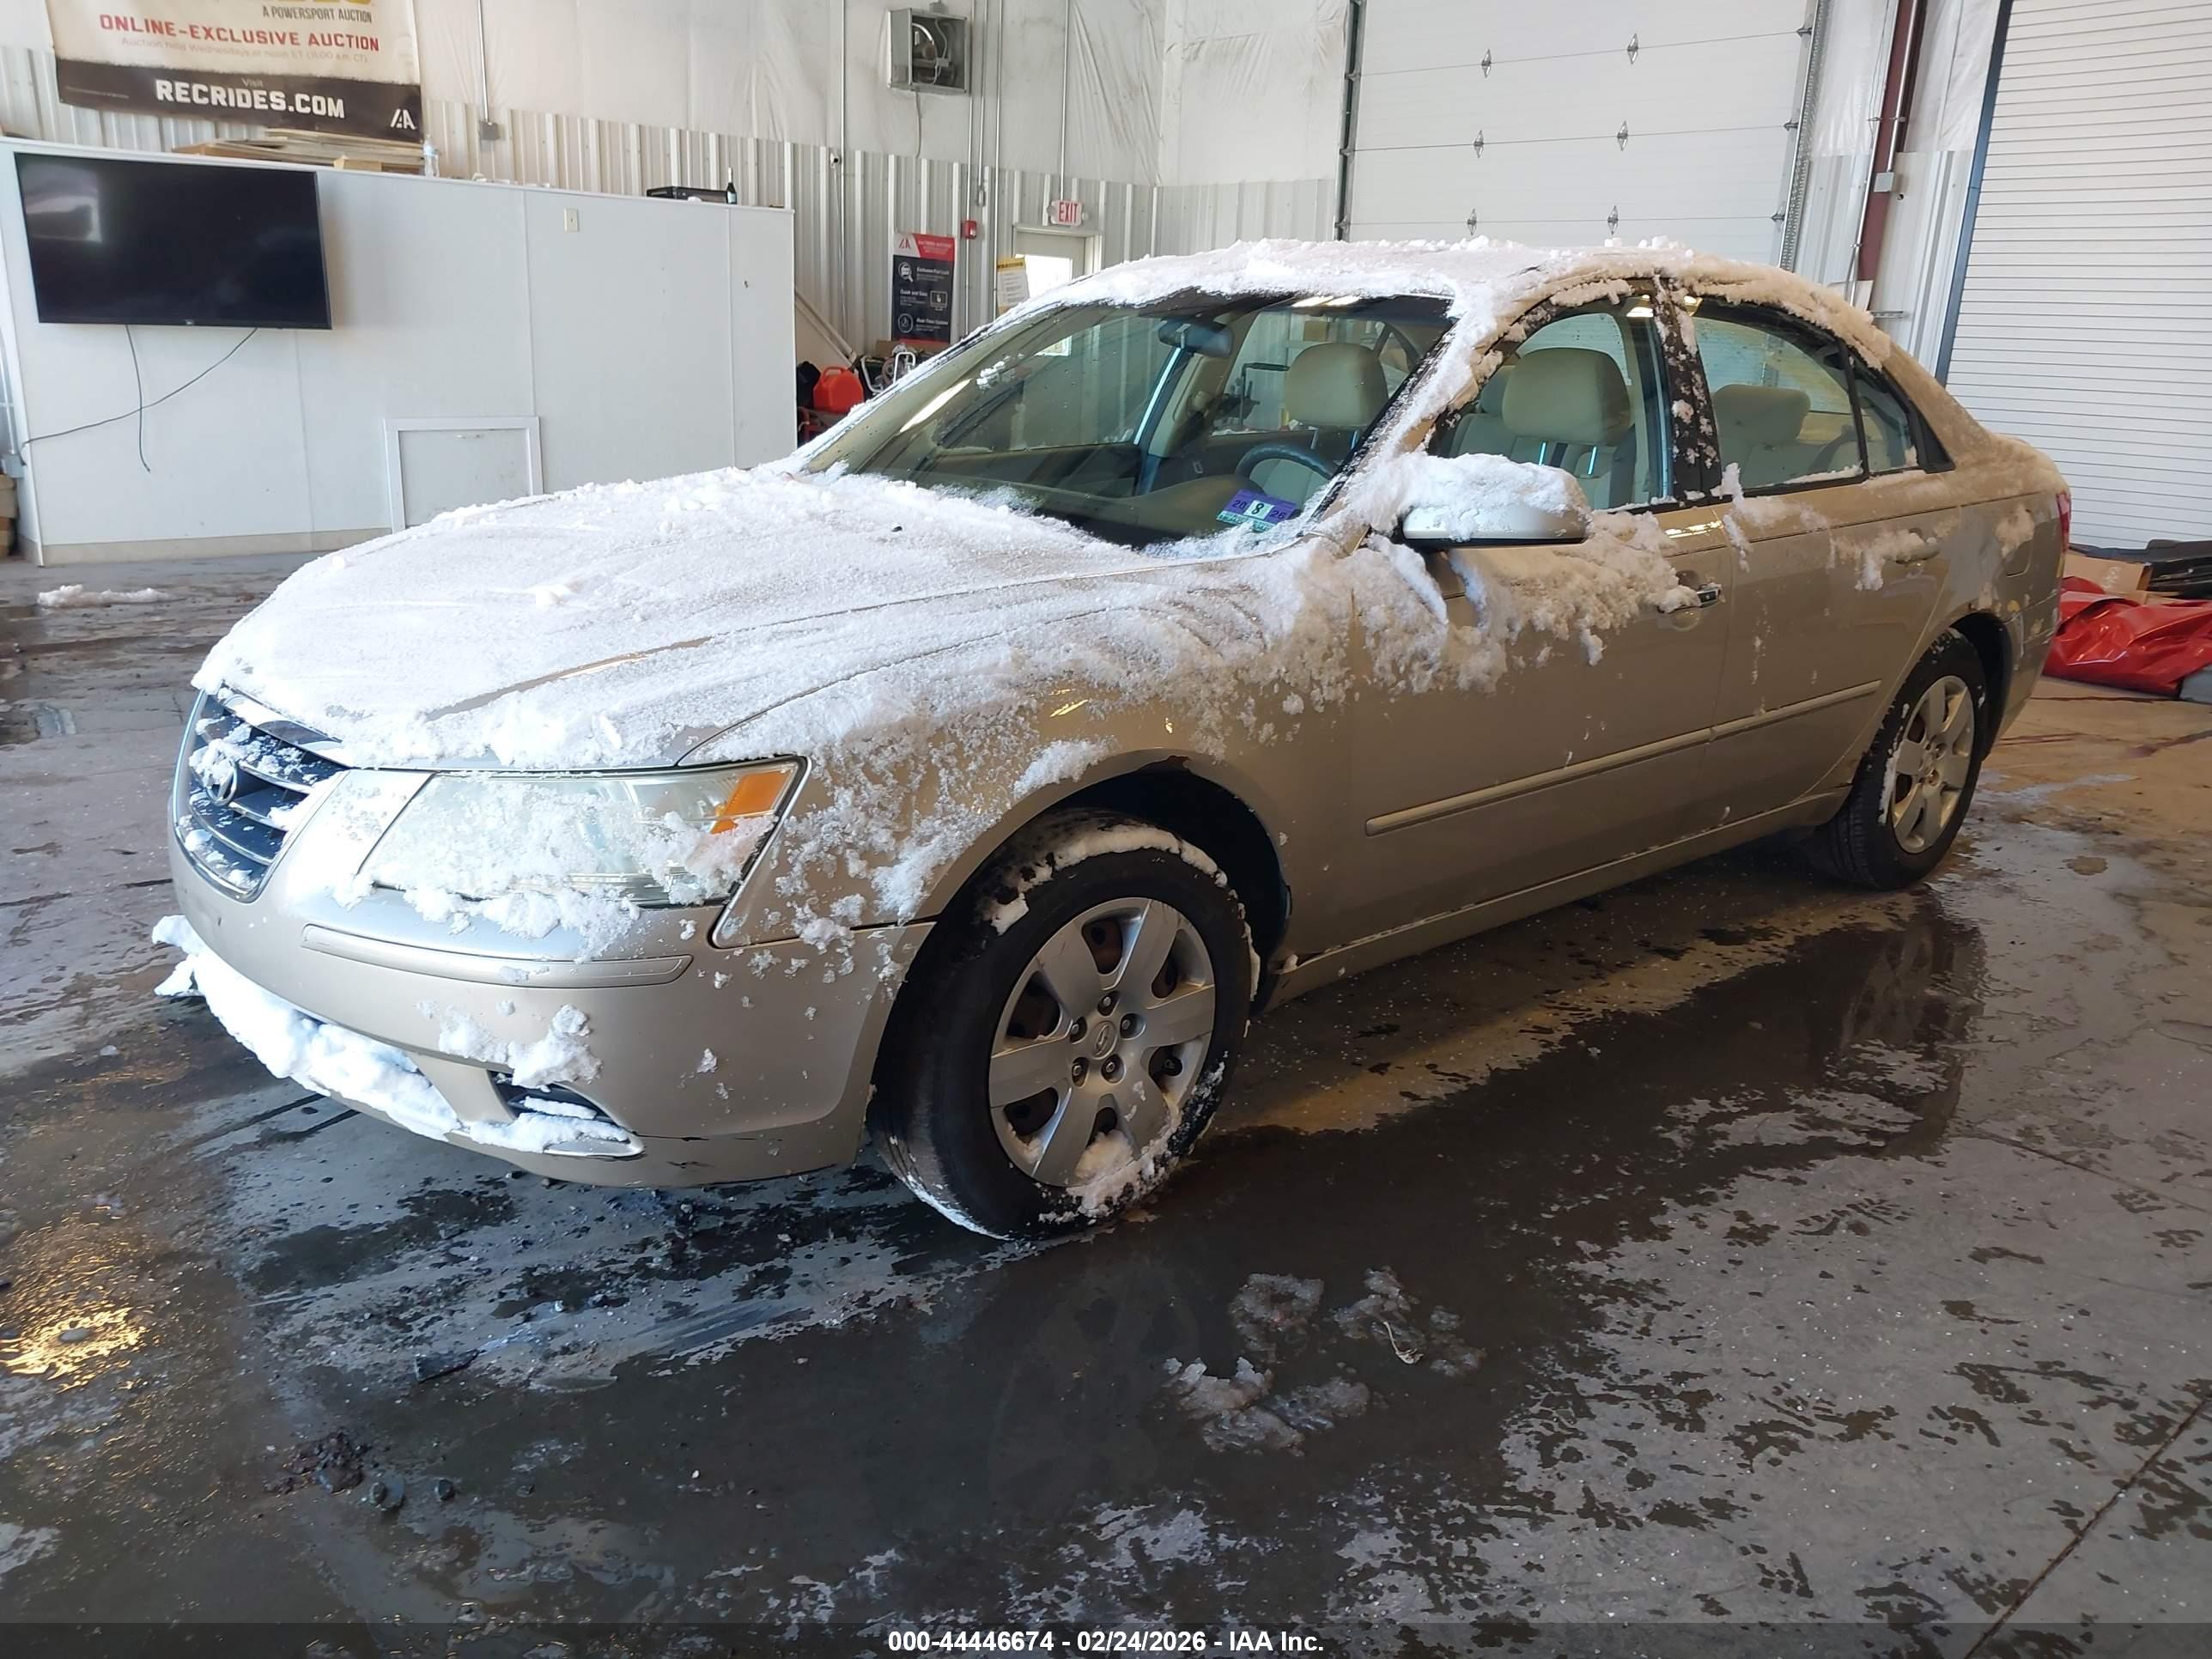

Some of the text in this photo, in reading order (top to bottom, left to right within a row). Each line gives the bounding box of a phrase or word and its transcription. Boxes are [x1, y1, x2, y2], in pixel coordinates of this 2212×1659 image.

[262, 6, 373, 23] A POWERSPORT AUCTION
[99, 14, 380, 52] ONLINE-EXCLUSIVE AUCTION
[155, 79, 345, 118] RECRIDES.COM
[1059, 201, 1079, 223] EXIT
[1231, 500, 1286, 520] 20 8 26
